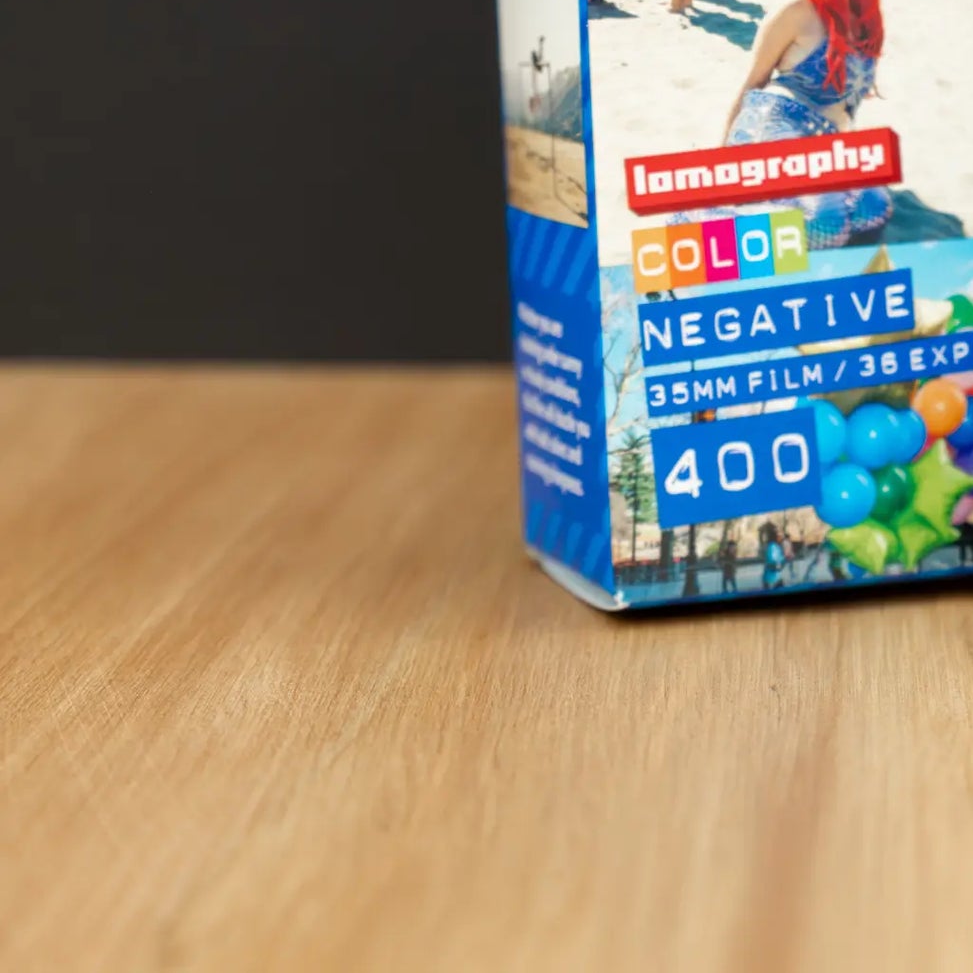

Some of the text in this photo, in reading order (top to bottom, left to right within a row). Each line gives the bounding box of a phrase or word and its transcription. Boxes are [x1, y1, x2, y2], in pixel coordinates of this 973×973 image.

[633, 140, 884, 195] lomography
[637, 226, 803, 276] COLOR
[643, 284, 910, 351] NEGATIVE
[649, 377, 737, 407] 35MM
[748, 363, 824, 394] FILM
[665, 433, 810, 498] 400
